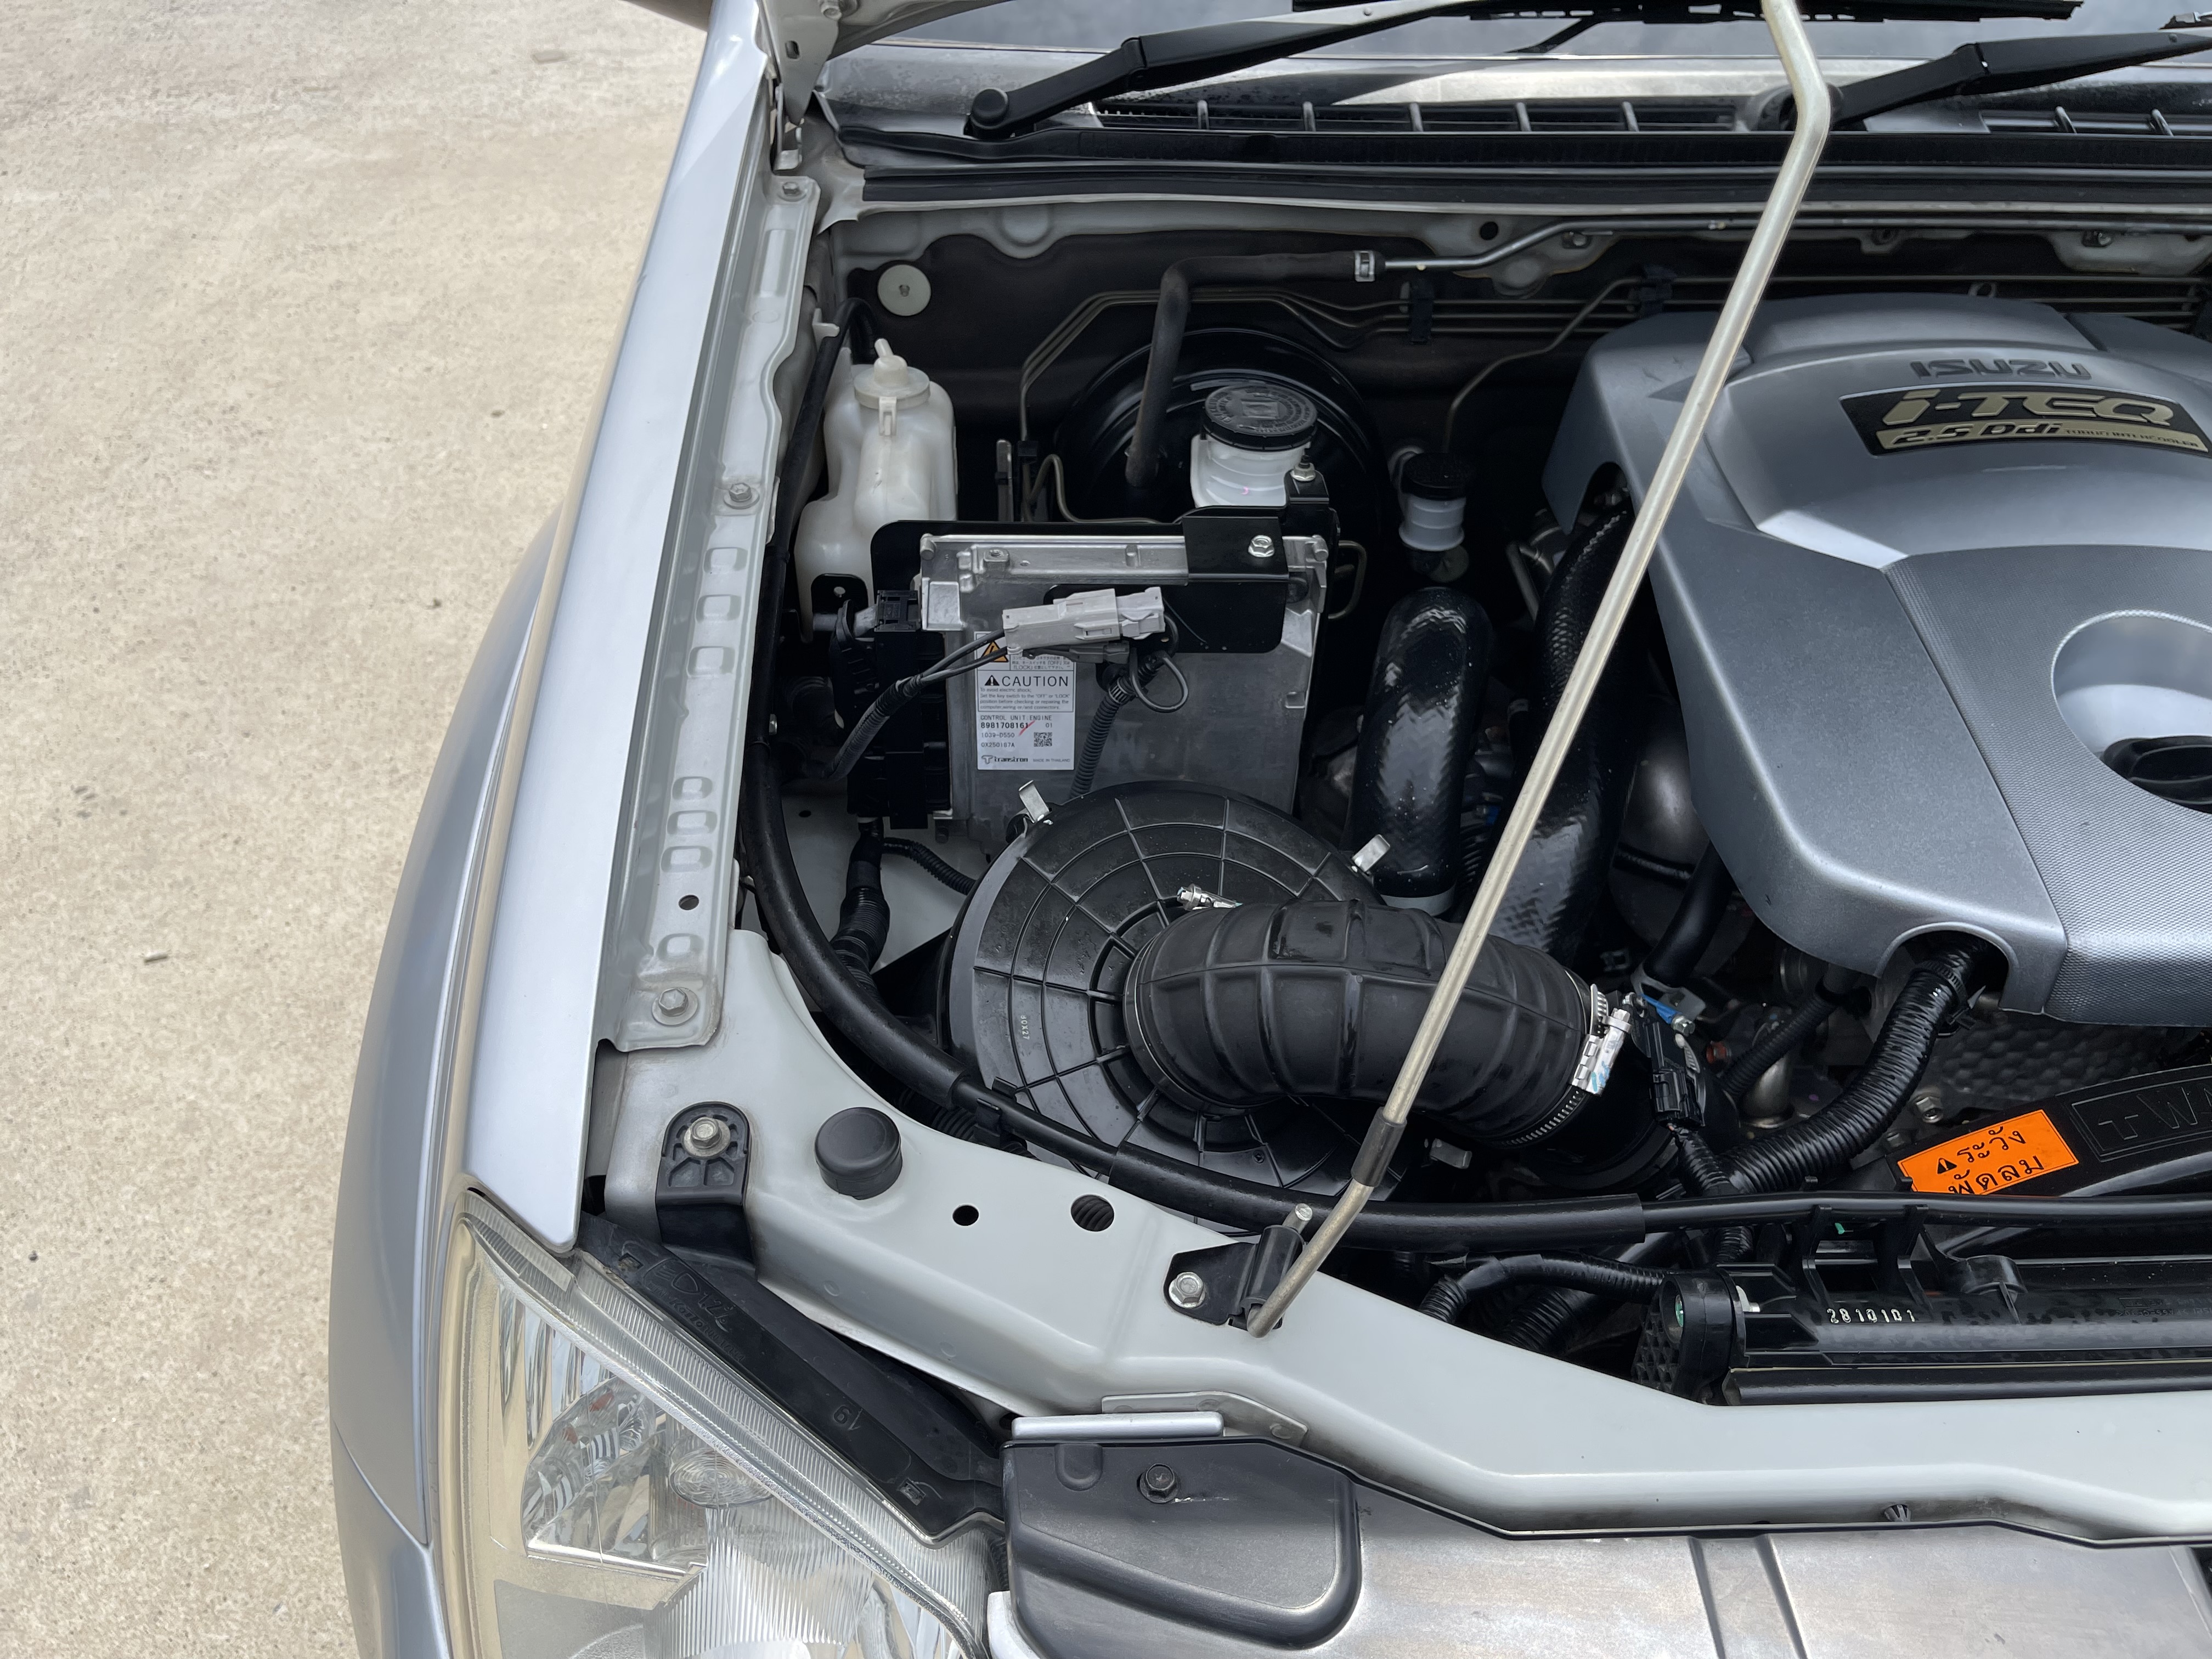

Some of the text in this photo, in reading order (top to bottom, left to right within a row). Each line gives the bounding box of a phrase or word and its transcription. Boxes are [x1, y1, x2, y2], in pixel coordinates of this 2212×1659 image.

[1910, 358, 2092, 380] ISUZU
[1979, 421, 2063, 436] Ddi
[1002, 676, 1069, 687] CAUTION
[1956, 1126, 2027, 1163] ระวัง
[1948, 1155, 2045, 1194] พัดลม
